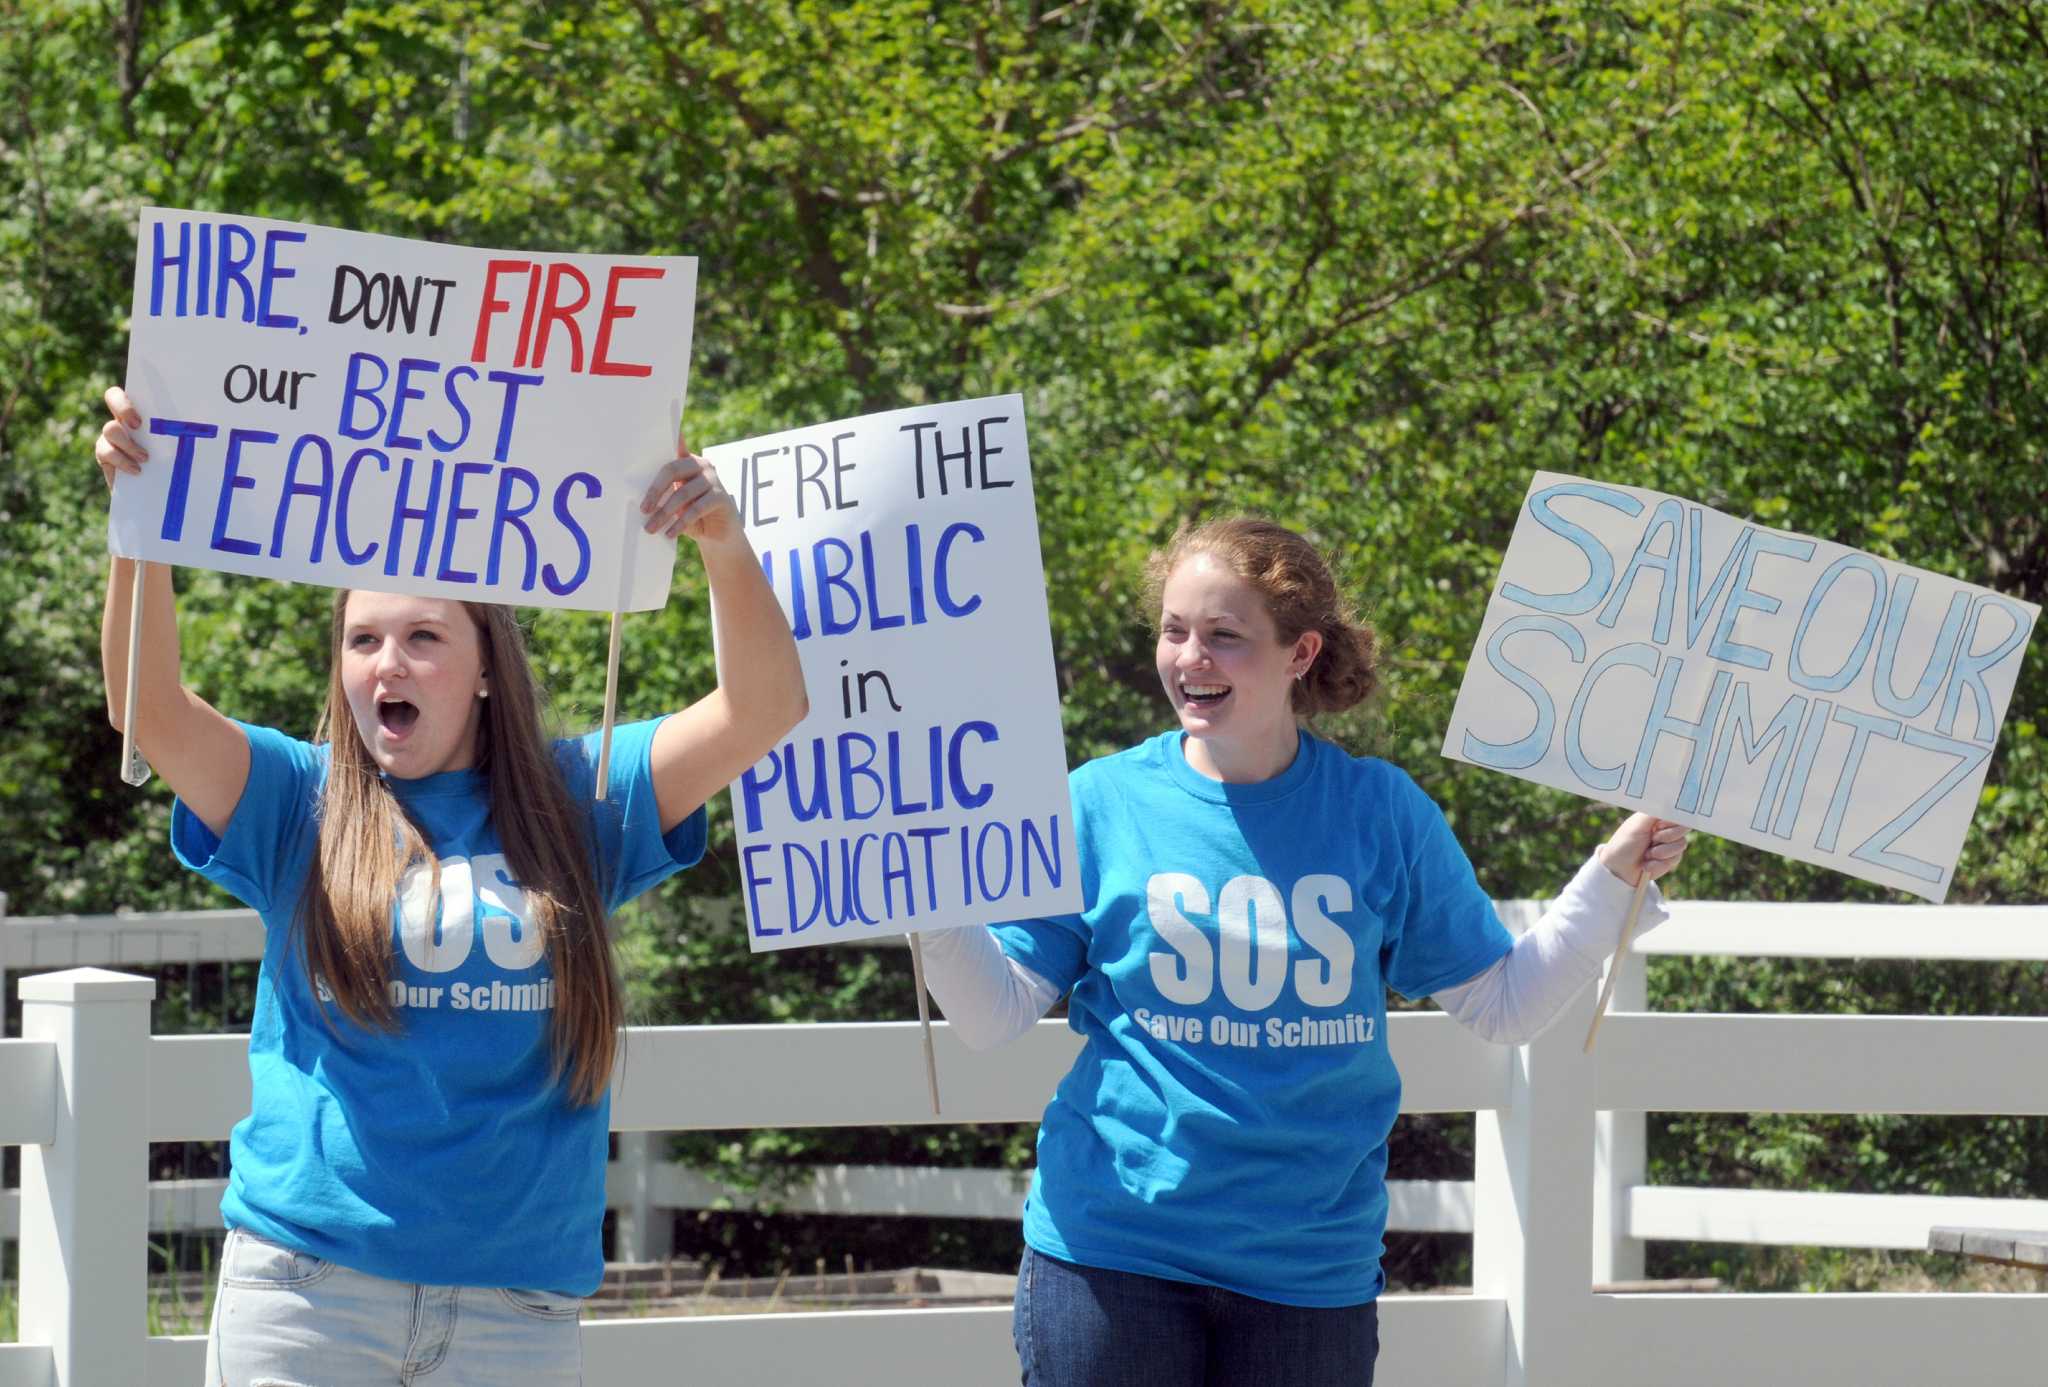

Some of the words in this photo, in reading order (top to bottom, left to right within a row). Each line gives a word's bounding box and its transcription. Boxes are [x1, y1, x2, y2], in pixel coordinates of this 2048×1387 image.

[328, 264, 457, 337] DON'T
[471, 259, 666, 377] FIRE
[223, 364, 317, 410] our
[338, 352, 544, 462] BEST
[900, 416, 1015, 499] THE
[149, 417, 602, 596] TEACHERS
[762, 522, 986, 641] UBLIC
[1500, 483, 1818, 671] SAVE
[1787, 552, 2032, 744] OUR
[840, 659, 902, 719] in
[1461, 614, 1993, 884] SCHMITZ
[400, 853, 547, 973] OS
[743, 814, 1063, 938] EDUCATION
[450, 977, 556, 1011] Schmit
[1147, 872, 1355, 1011] SOS
[1134, 1008, 1203, 1044] Save
[1210, 1015, 1260, 1048] Our
[1266, 1013, 1375, 1047] Schmitz
